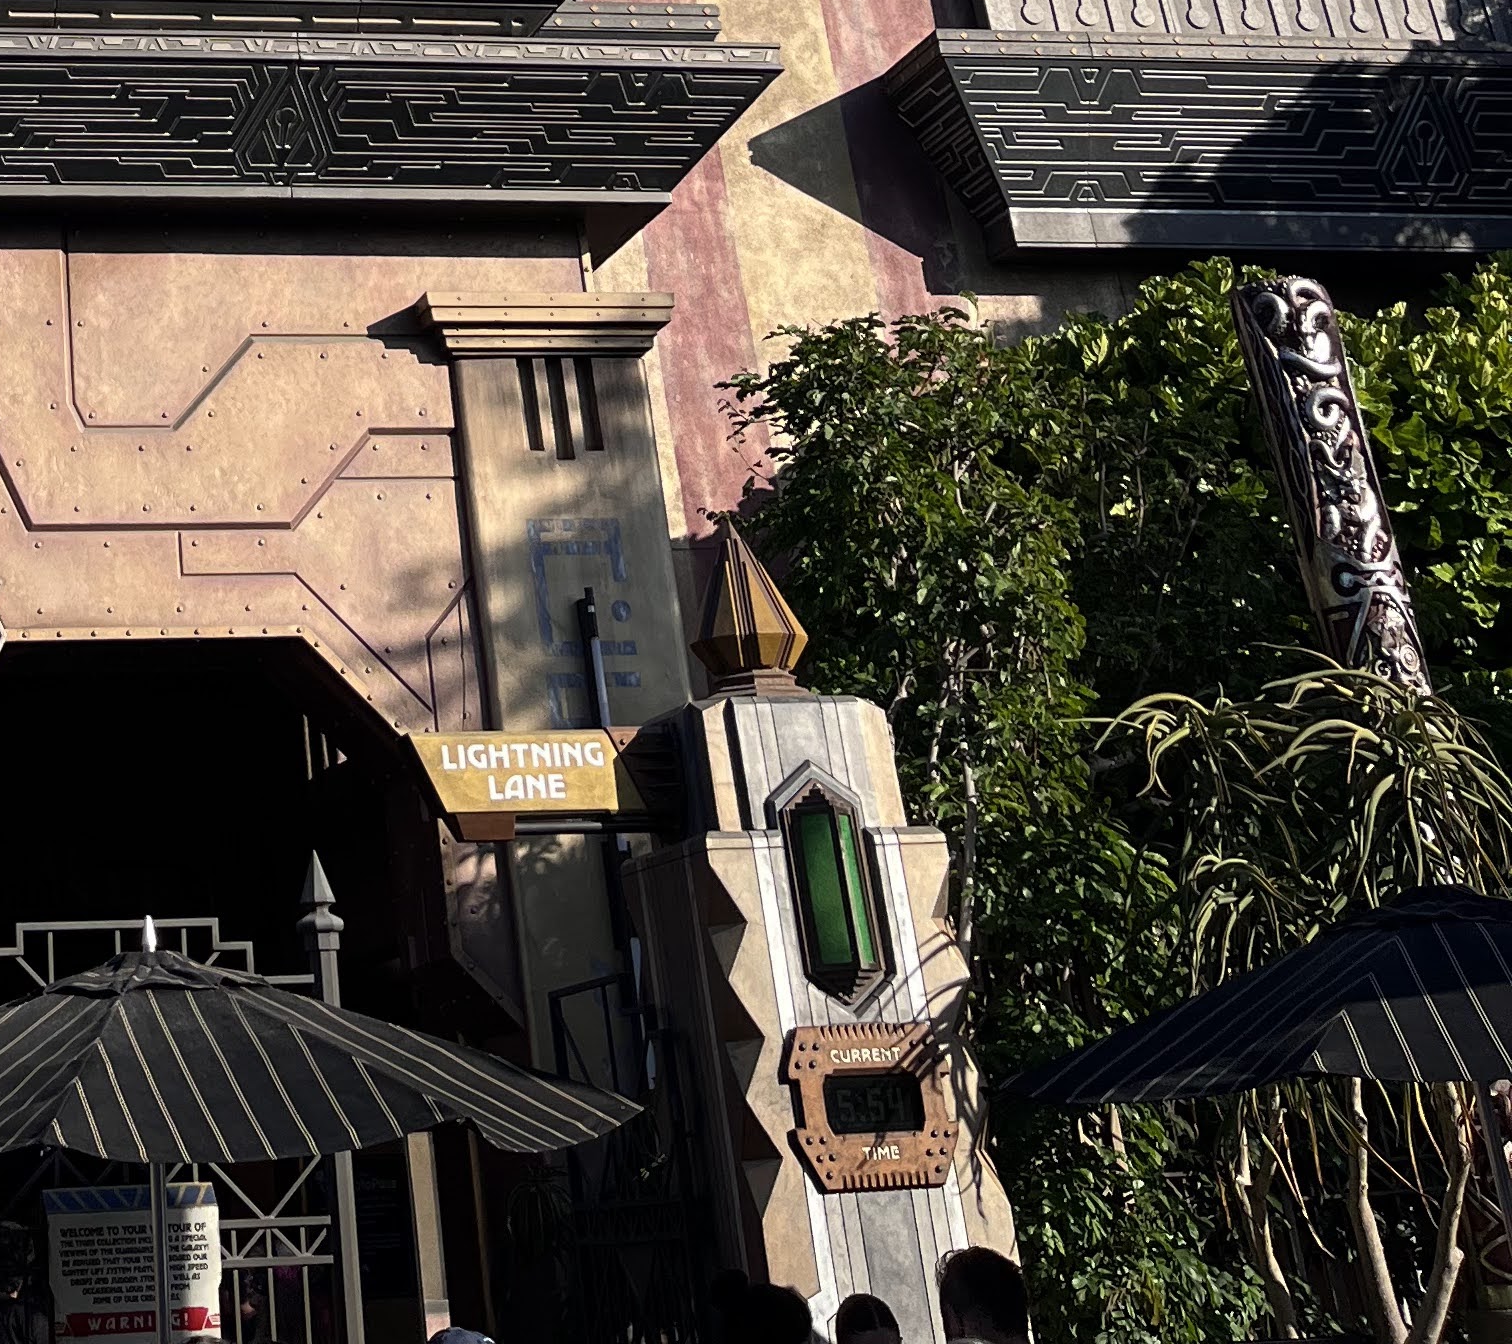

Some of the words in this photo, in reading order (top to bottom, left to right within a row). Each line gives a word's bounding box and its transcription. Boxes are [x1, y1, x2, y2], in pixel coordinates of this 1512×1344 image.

[441, 741, 605, 770] LIGHTNING
[488, 773, 566, 801] LANE
[830, 1047, 902, 1064] CURRENT
[862, 1145, 901, 1160] TIME
[60, 1227, 104, 1237] WELCOME
[107, 1226, 119, 1235] TO
[122, 1225, 146, 1234] YOUR
[168, 1223, 191, 1232] TOUR
[194, 1223, 206, 1231] OF
[88, 1314, 189, 1330] WARNIG!
